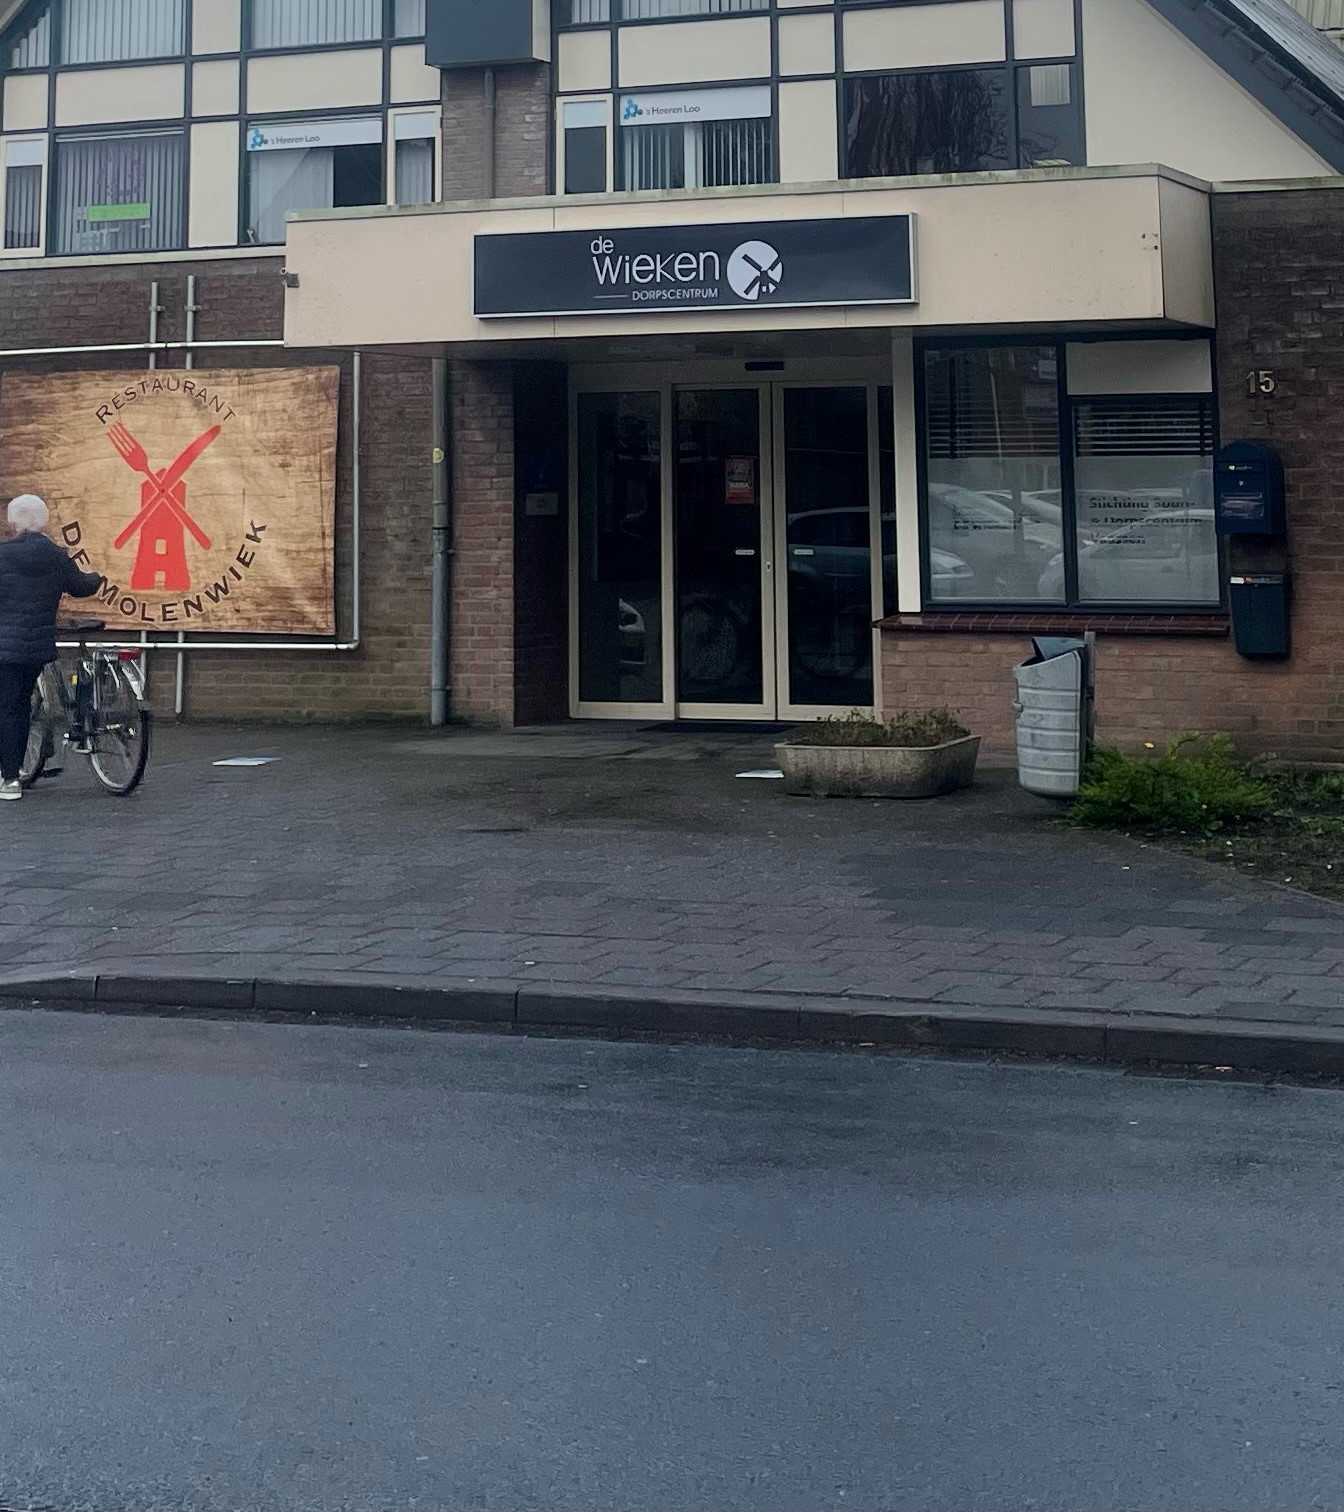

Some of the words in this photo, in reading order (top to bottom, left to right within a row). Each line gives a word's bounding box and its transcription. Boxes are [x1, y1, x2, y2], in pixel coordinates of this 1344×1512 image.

[590, 235, 614, 254] de
[592, 251, 720, 285] Wieken
[632, 287, 718, 301] DORPSCENTRUM
[1246, 370, 1275, 393] 15
[95, 376, 237, 425] RESTAURANT
[96, 519, 268, 623] MOLENWIEK
